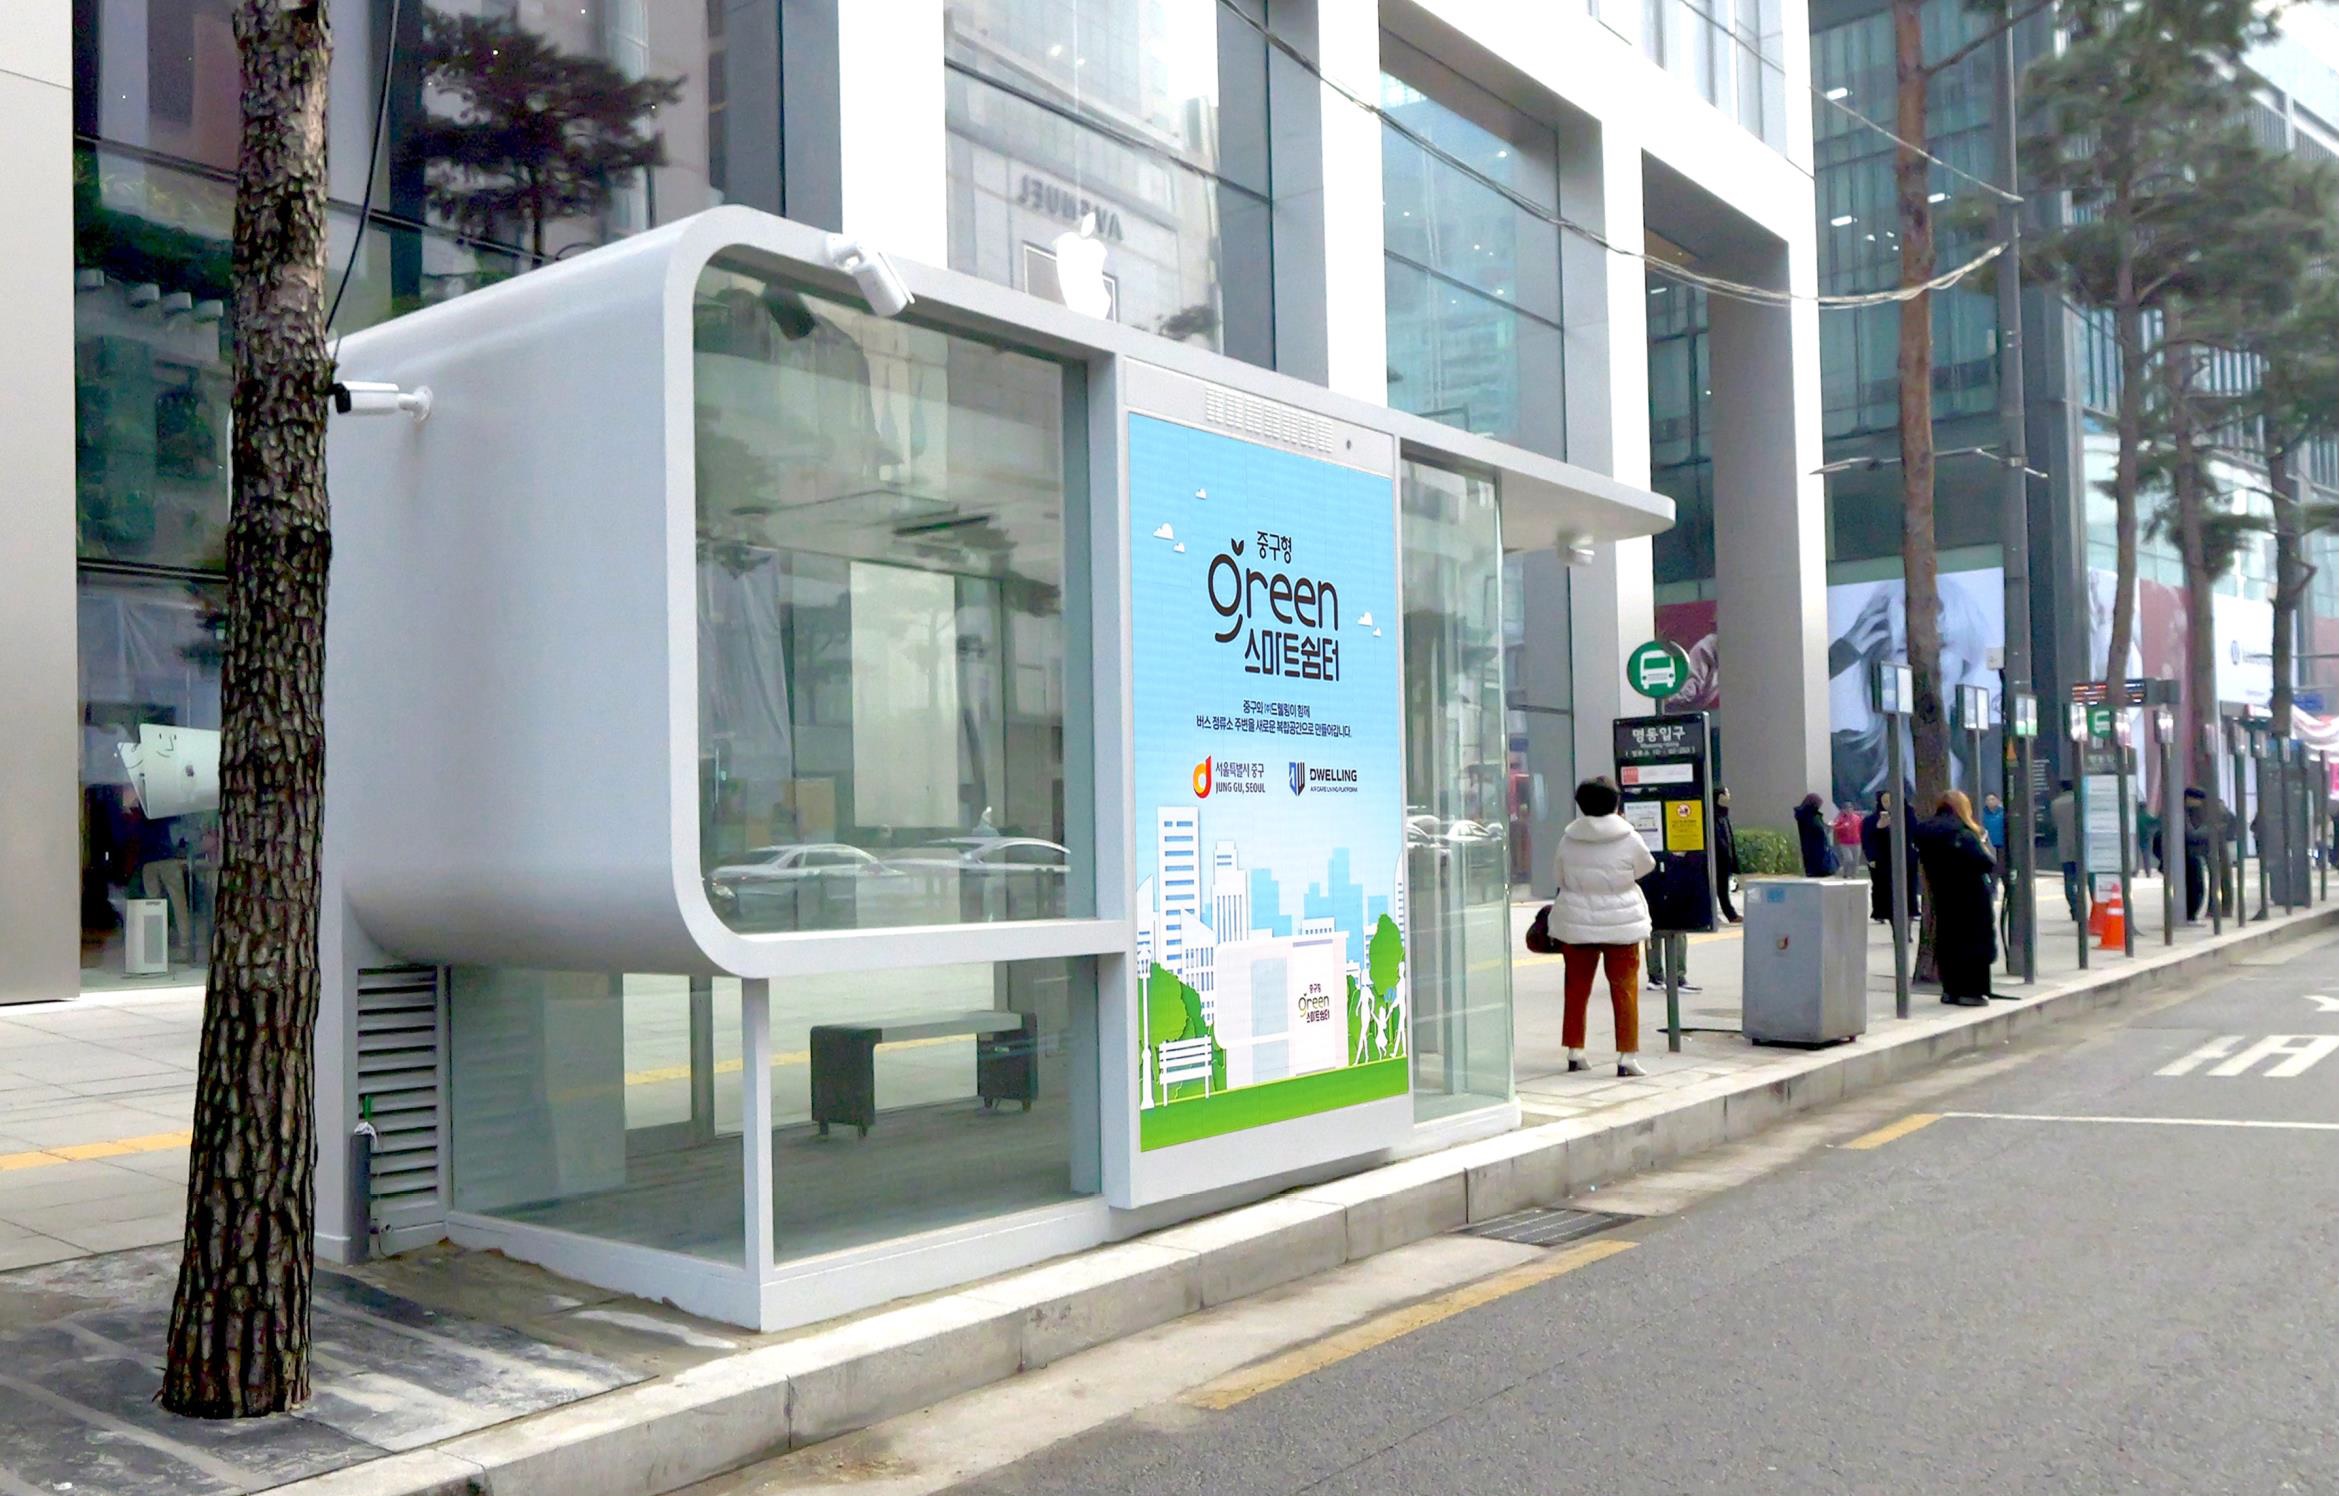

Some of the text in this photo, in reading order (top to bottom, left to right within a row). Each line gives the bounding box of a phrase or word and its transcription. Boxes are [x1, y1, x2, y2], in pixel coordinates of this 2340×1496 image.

[1256, 531, 1292, 564] 중구형
[1208, 552, 1338, 643] green
[1244, 628, 1340, 681] 스마트쉼터
[1196, 715, 1211, 729] 버스
[1212, 716, 1233, 731] 정류소
[1234, 718, 1255, 732] 주변을
[1256, 719, 1276, 733] 새로운
[1276, 720, 1314, 735] 복합공간으로
[1632, 726, 1686, 743] 명동입구
[1215, 761, 1265, 778] 서울특별시 중구
[1309, 768, 1357, 782] DWELLING
[1215, 782, 1266, 794] JUNG GU, SEOUL
[1298, 995, 1329, 1018] green
